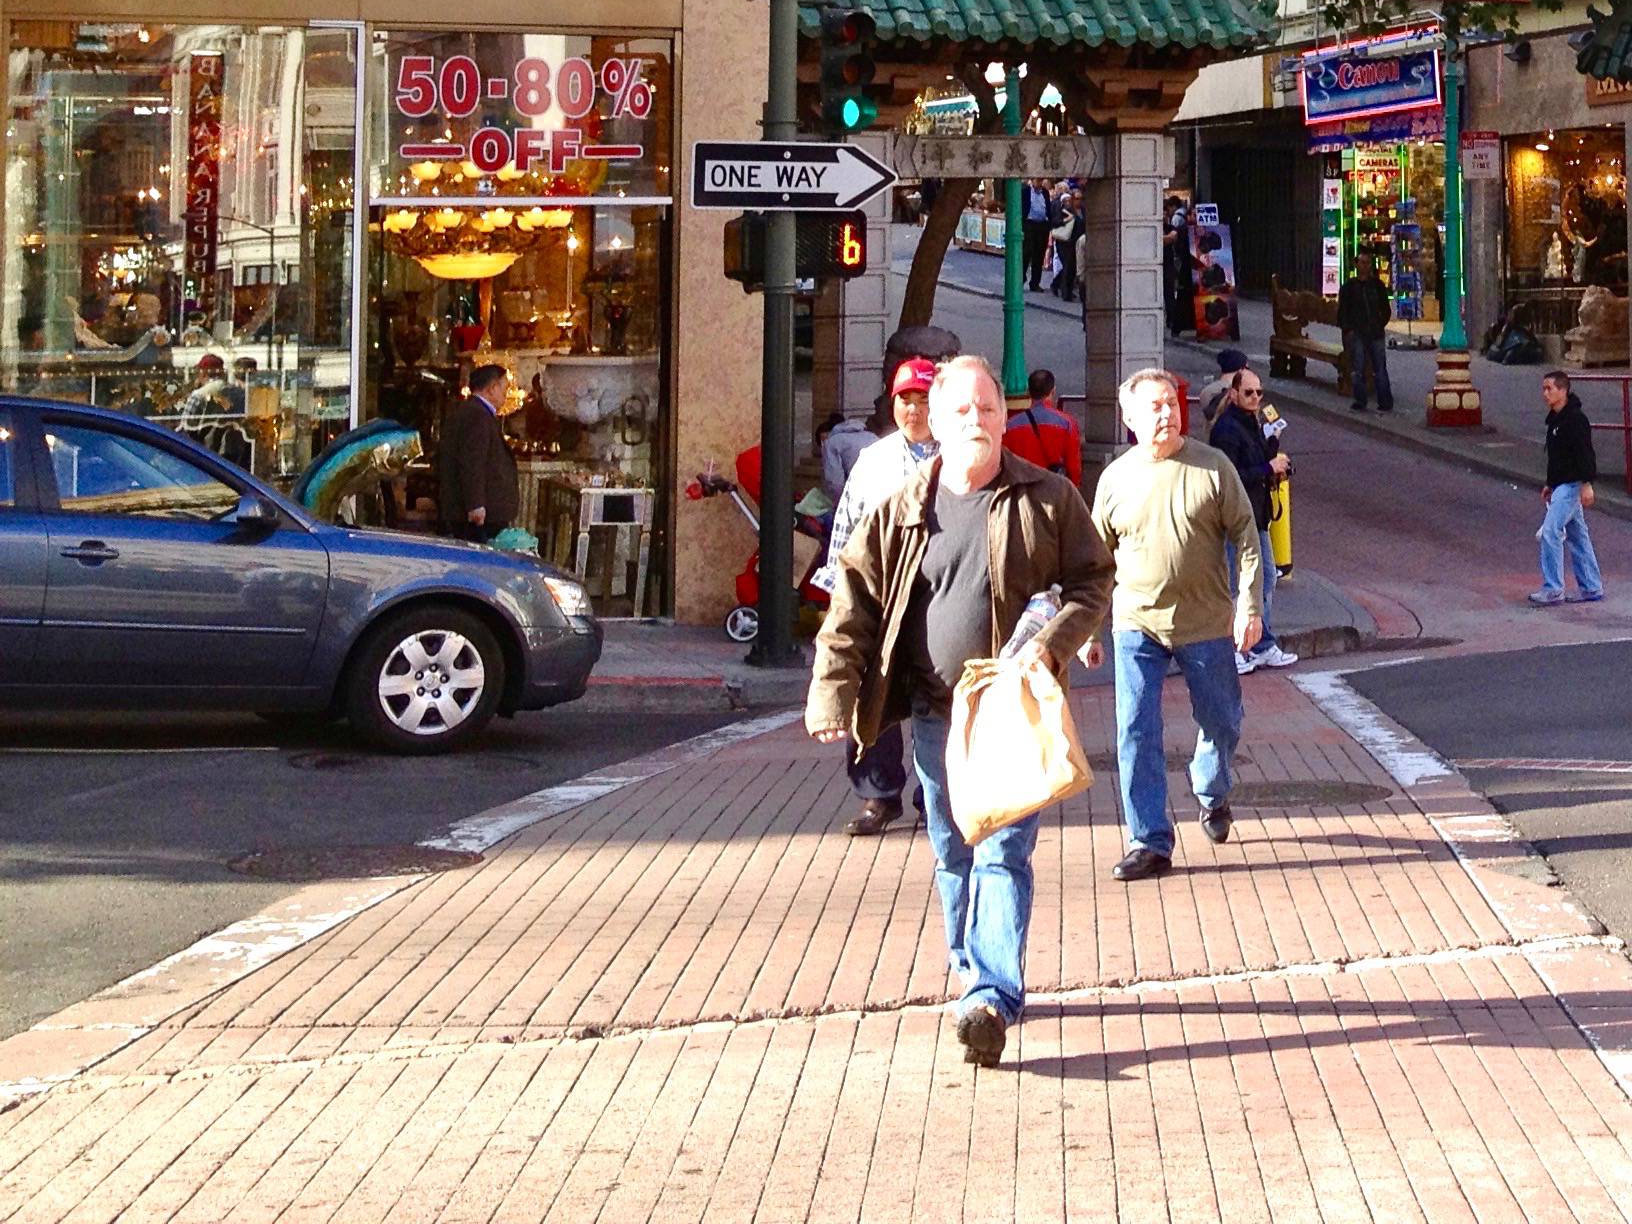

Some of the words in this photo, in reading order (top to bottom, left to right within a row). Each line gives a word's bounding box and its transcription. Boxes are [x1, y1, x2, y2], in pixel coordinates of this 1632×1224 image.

[396, 55, 652, 119] 50-80%
[1338, 60, 1400, 90] Canon
[469, 127, 582, 174] OFF
[1359, 158, 1399, 167] CAMERAS
[710, 164, 762, 188] ONE
[775, 165, 828, 189] WAY
[1198, 214, 1217, 223] ATM
